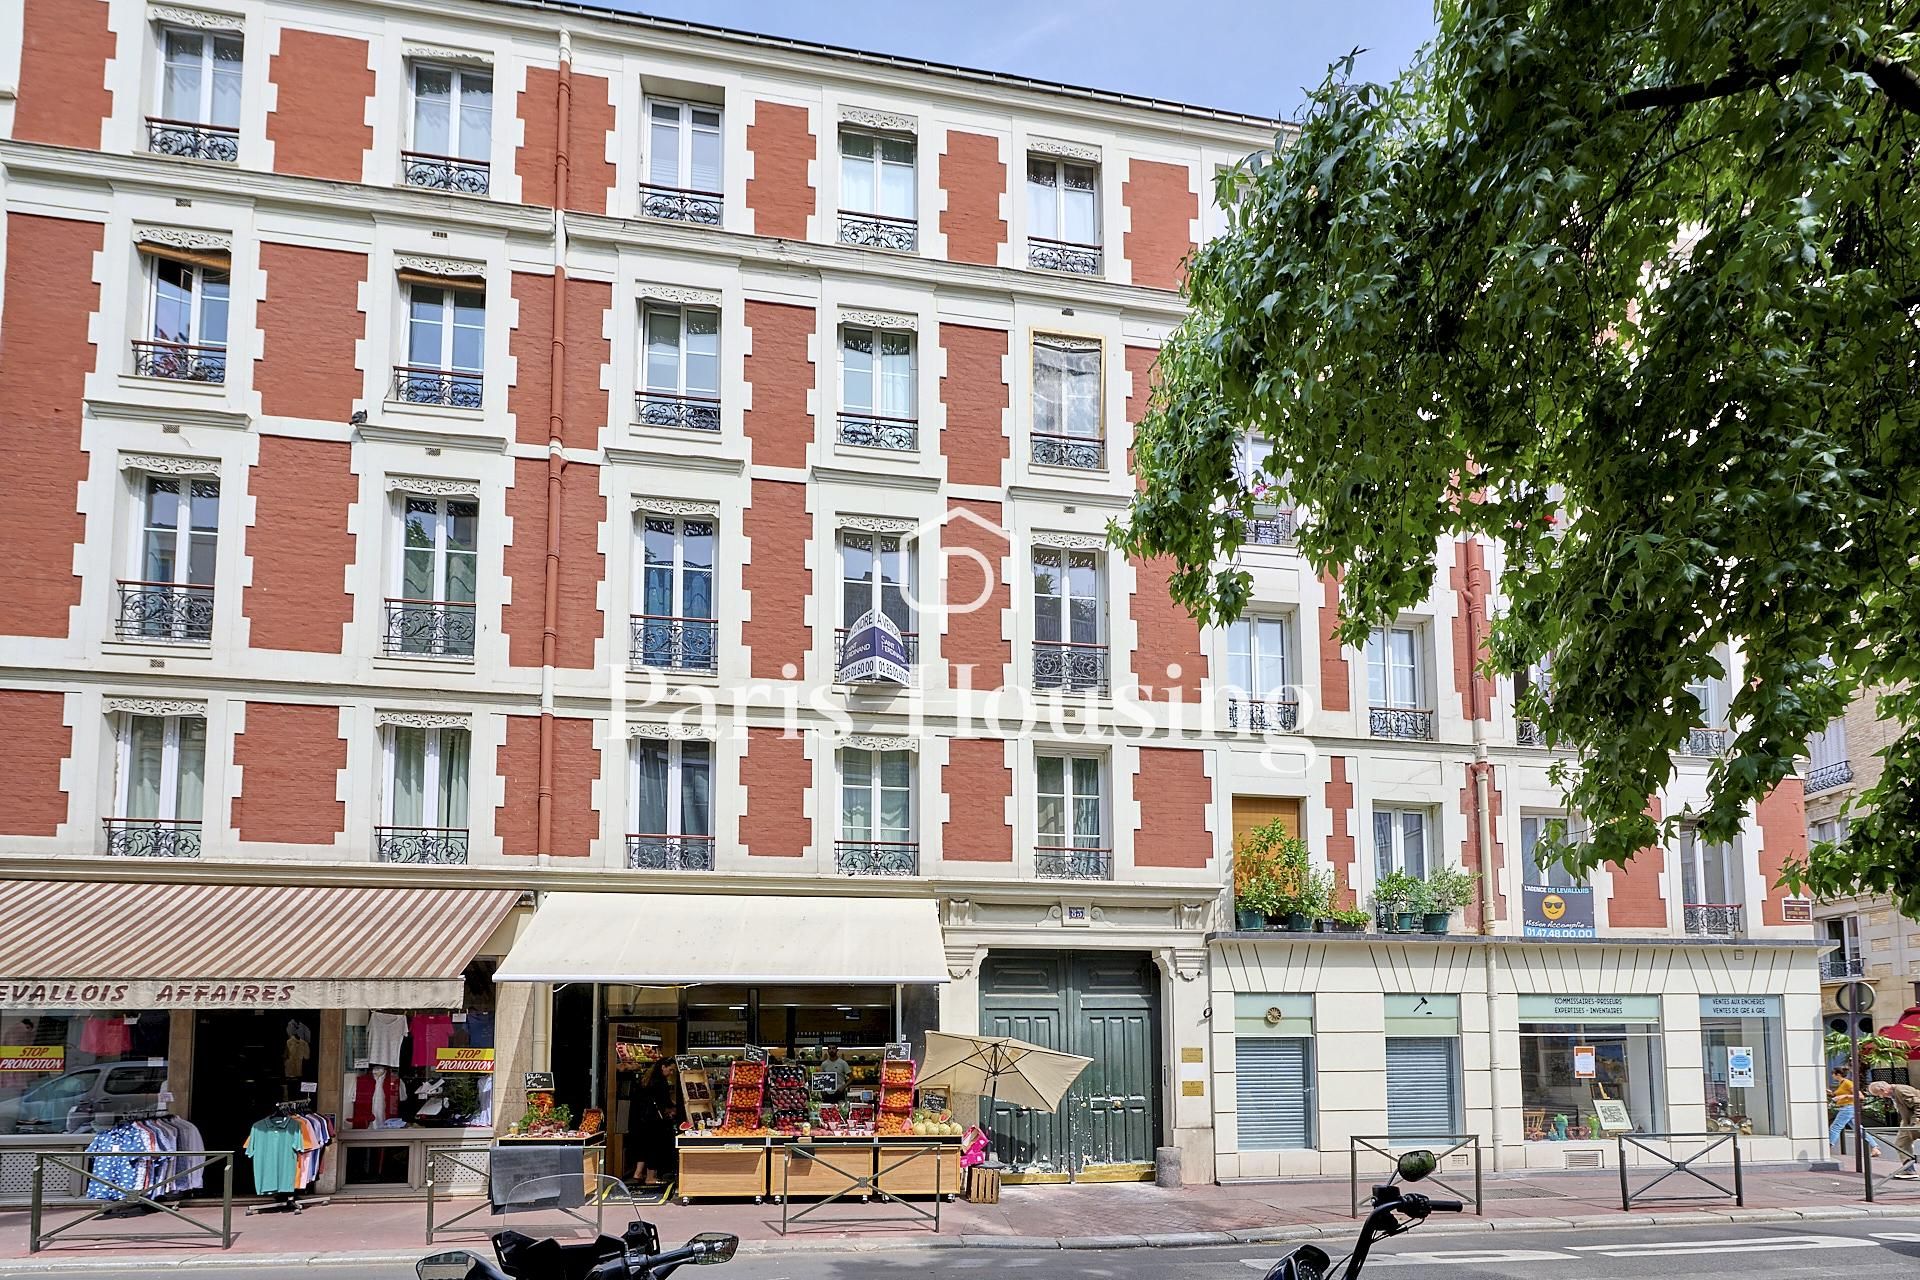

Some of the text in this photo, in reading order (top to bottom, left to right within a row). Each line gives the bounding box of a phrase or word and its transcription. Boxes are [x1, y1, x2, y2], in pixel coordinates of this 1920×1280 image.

[880, 635, 895, 649] SAINT
[881, 641, 906, 663] FERDINAND
[1556, 887, 1590, 895] LEVALLOIS
[1525, 920, 1547, 928] Mission
[156, 985, 295, 1002] AFFAIRES
[1554, 997, 1623, 1005] COMMISSAIRES-PRISEURS
[20, 1047, 49, 1057] STOP
[455, 1049, 481, 1058] STOP
[0, 1058, 64, 1069] PROMOTION
[435, 1060, 495, 1071] PROMOTION
